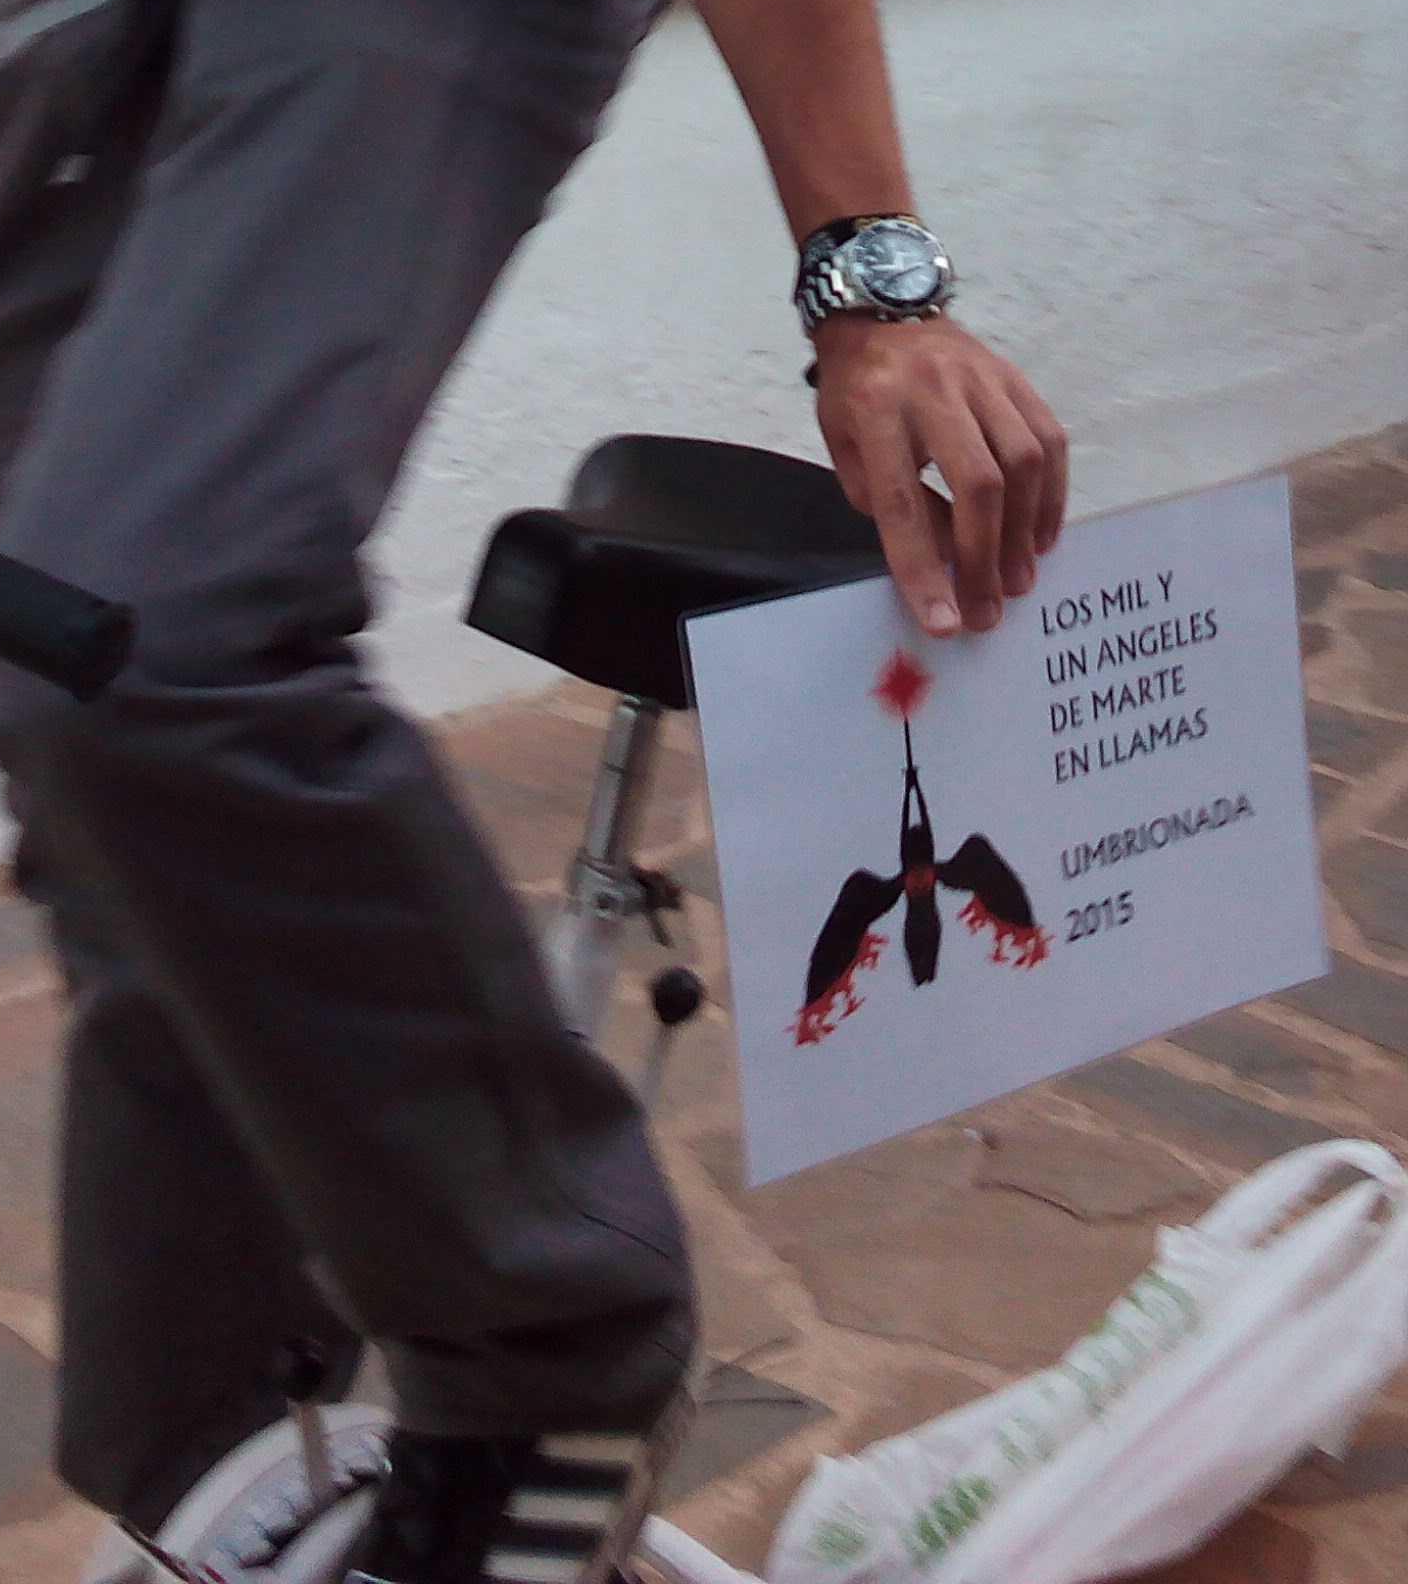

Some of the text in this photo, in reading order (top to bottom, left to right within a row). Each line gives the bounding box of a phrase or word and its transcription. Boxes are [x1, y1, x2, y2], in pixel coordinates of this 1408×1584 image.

[1040, 570, 1173, 637] LOS MIL Y
[1045, 608, 1218, 688] UN ANGELES
[1049, 665, 1186, 736] DE MARTE
[1054, 707, 1209, 784] EN LLAMAS
[1060, 793, 1255, 881] UMBRIONADA
[1065, 889, 1135, 945] 2015
